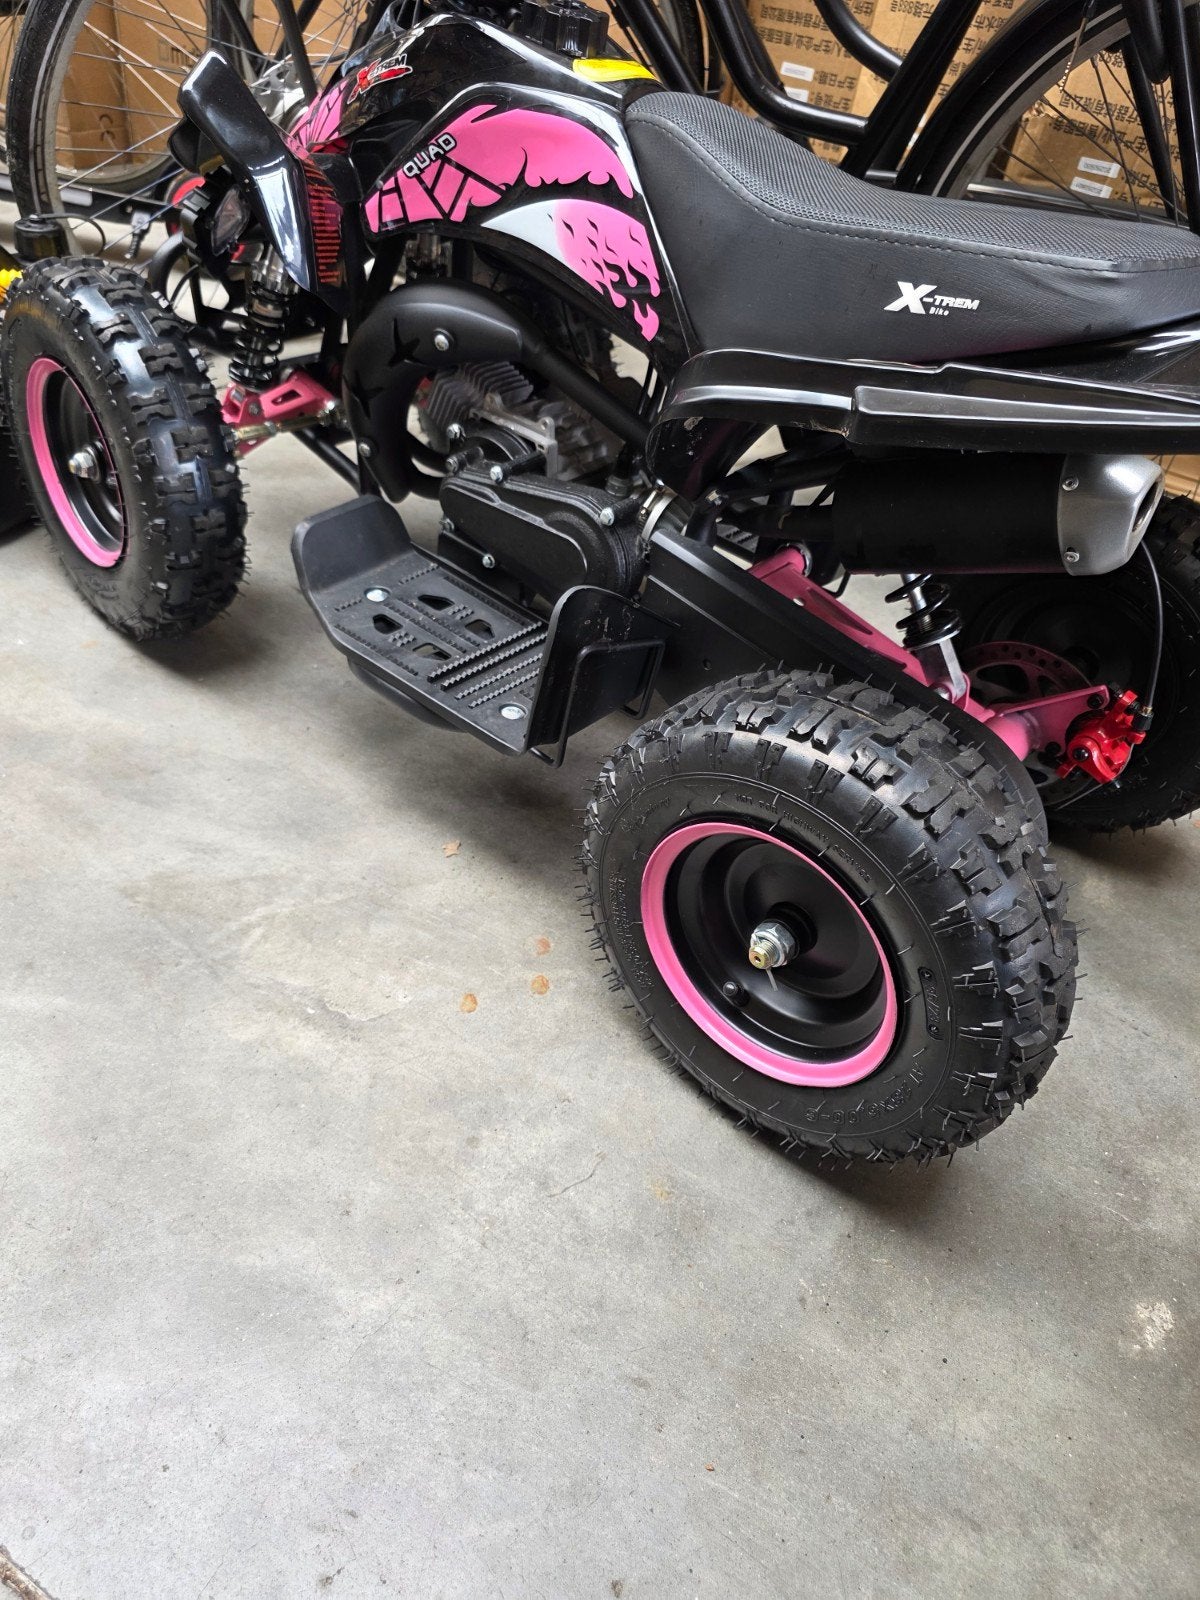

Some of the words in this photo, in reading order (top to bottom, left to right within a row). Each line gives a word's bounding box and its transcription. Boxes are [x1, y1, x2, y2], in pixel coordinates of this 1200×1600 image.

[403, 133, 457, 178] QUAD
[883, 281, 980, 314] X-TREM
[929, 307, 949, 316] Bike
